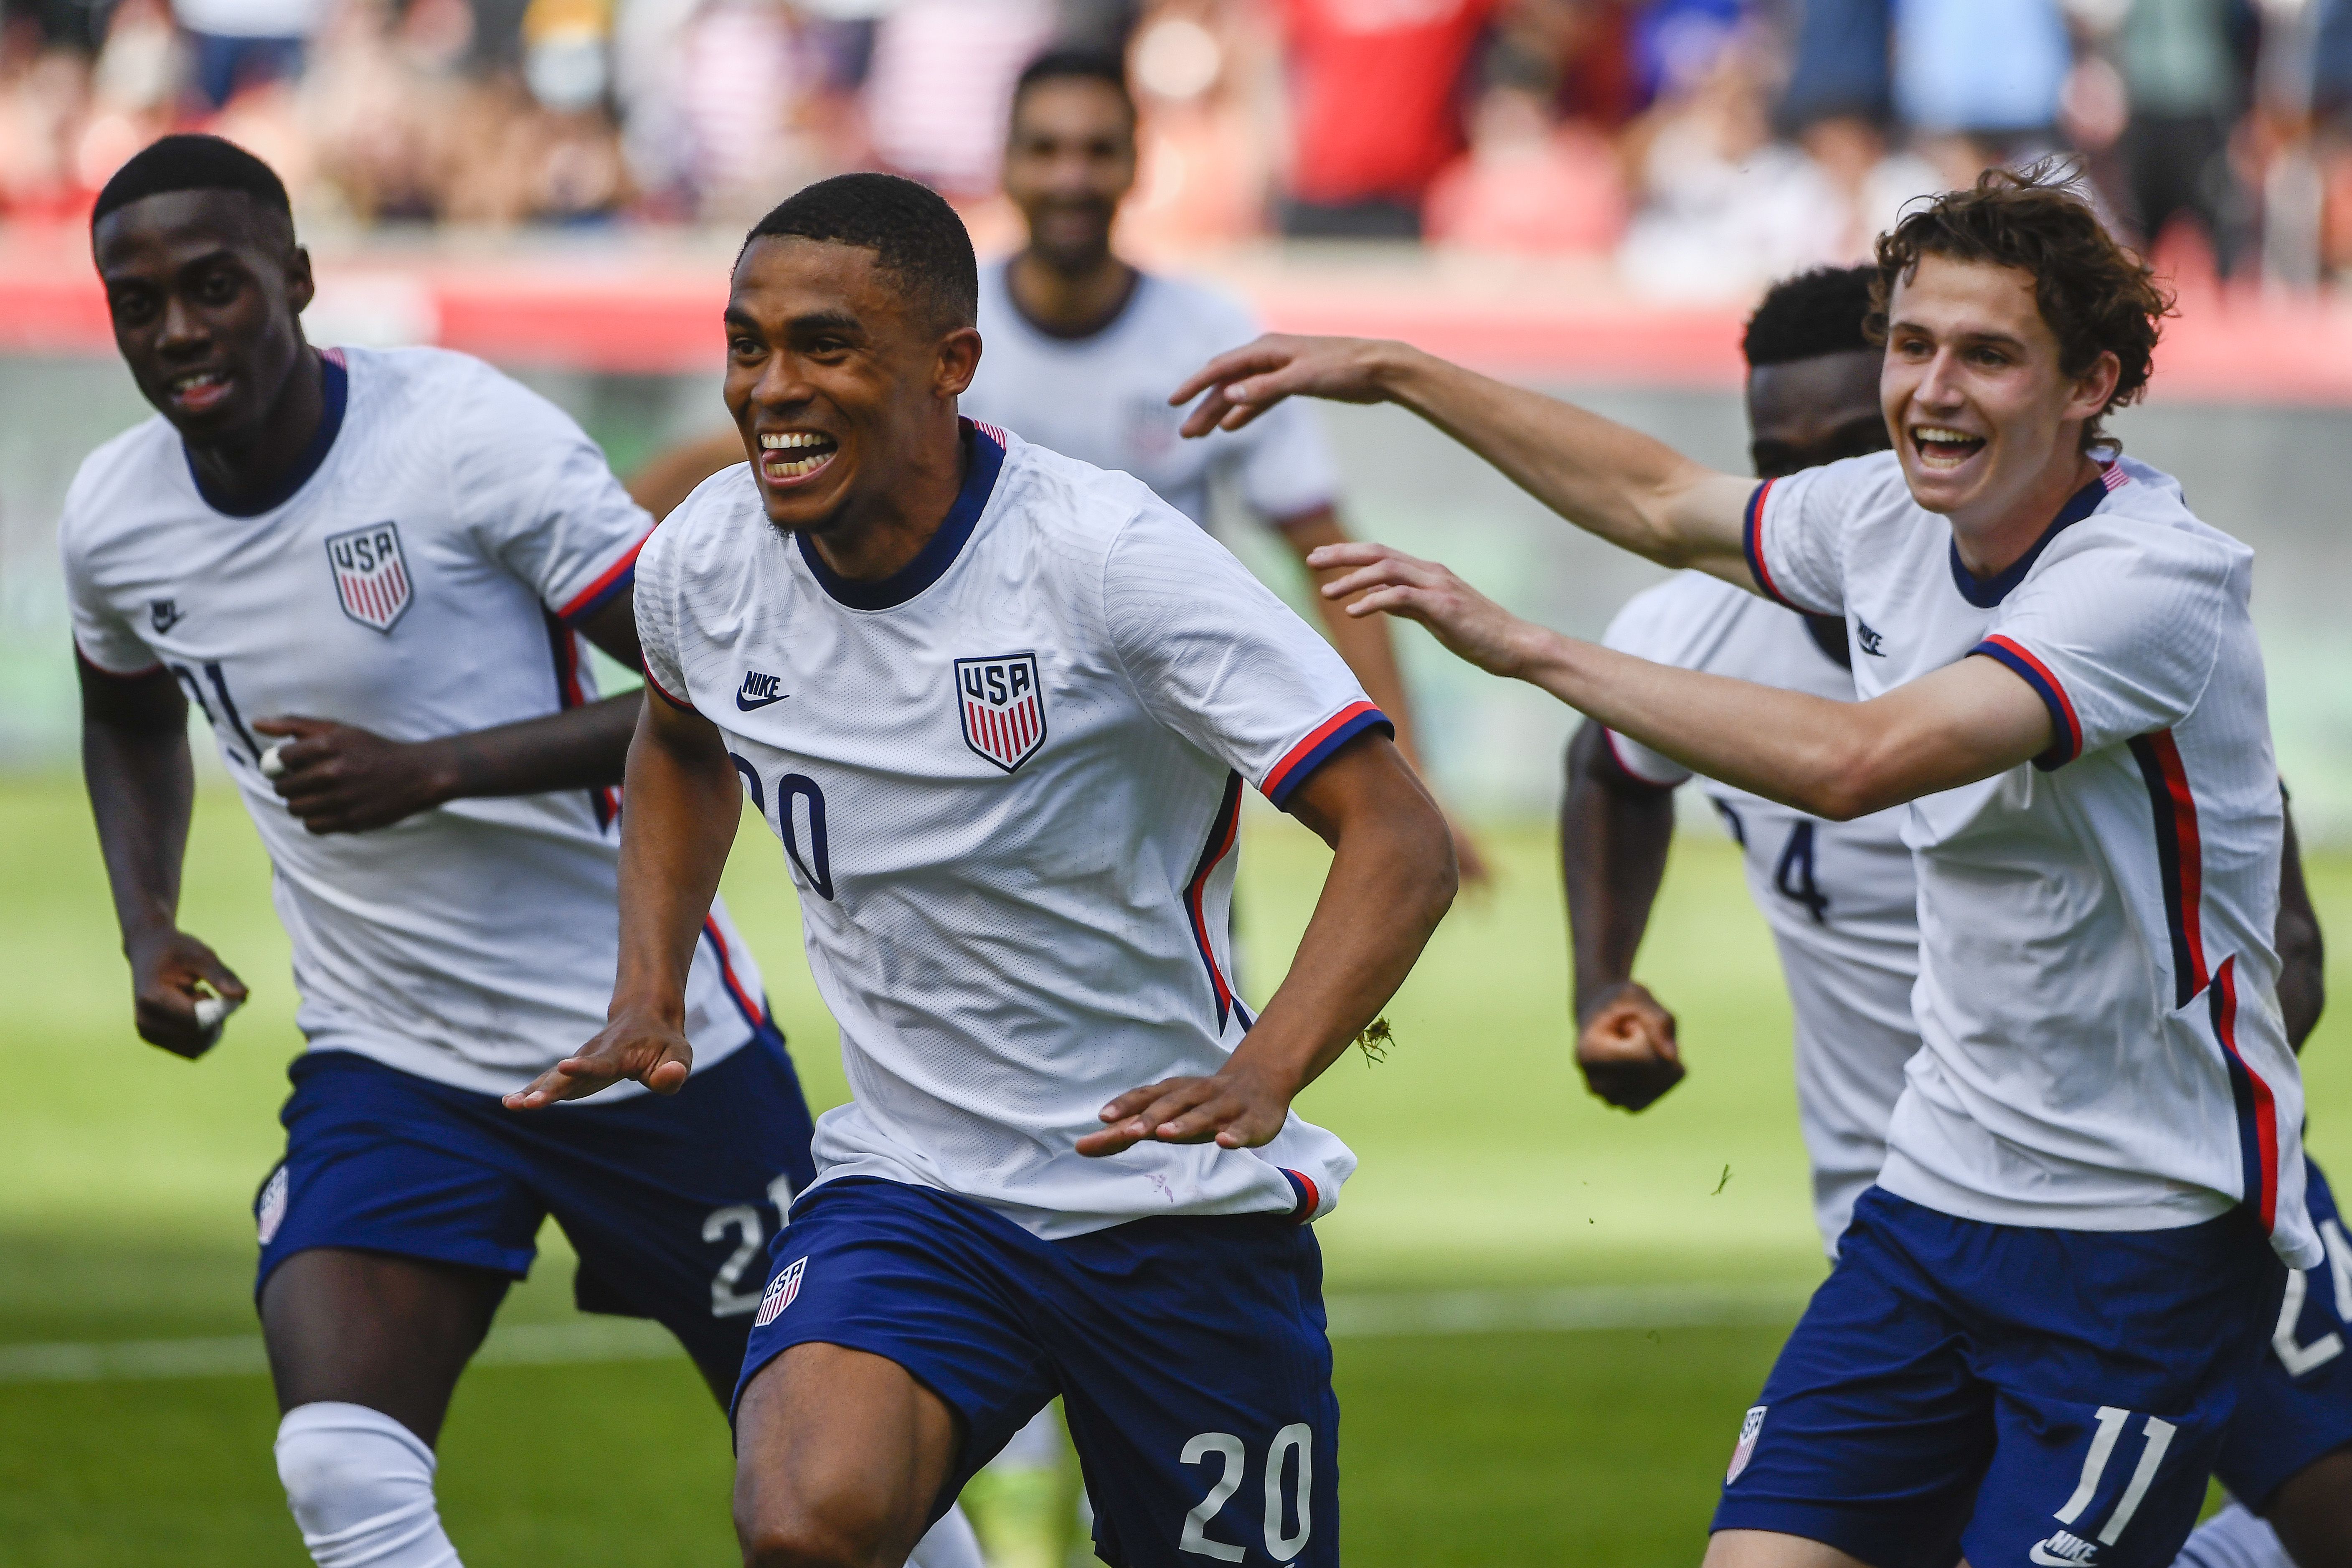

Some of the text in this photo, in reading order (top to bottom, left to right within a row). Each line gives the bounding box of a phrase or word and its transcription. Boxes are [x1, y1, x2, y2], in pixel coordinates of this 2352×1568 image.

[335, 532, 393, 572] USA
[742, 671, 780, 697] NIKE
[965, 664, 1030, 705] USA
[765, 1261, 804, 1299] USA
[1180, 1423, 1312, 1563] 20
[2053, 1406, 2177, 1547] 11
[2046, 1529, 2098, 1561] NIKE
